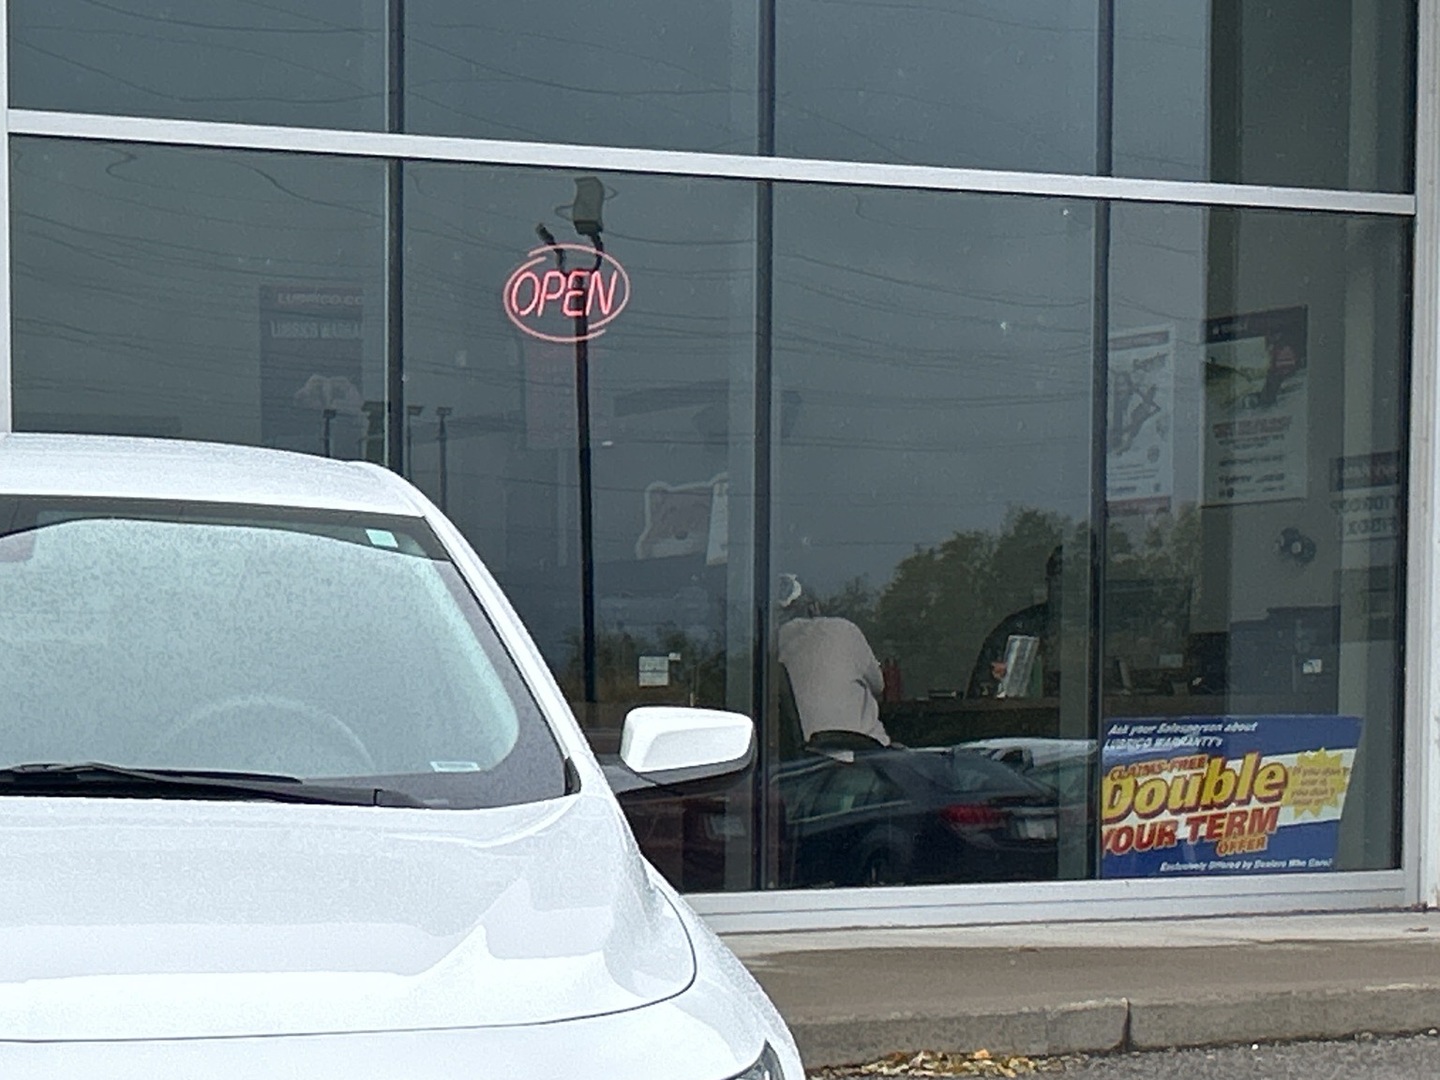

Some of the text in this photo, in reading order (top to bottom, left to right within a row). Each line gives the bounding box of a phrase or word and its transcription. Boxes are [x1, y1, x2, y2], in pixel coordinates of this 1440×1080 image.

[511, 269, 618, 317] OPEN
[1102, 752, 1287, 823] Double
[1186, 806, 1281, 844] TERM
[1217, 835, 1268, 857] OFFER
